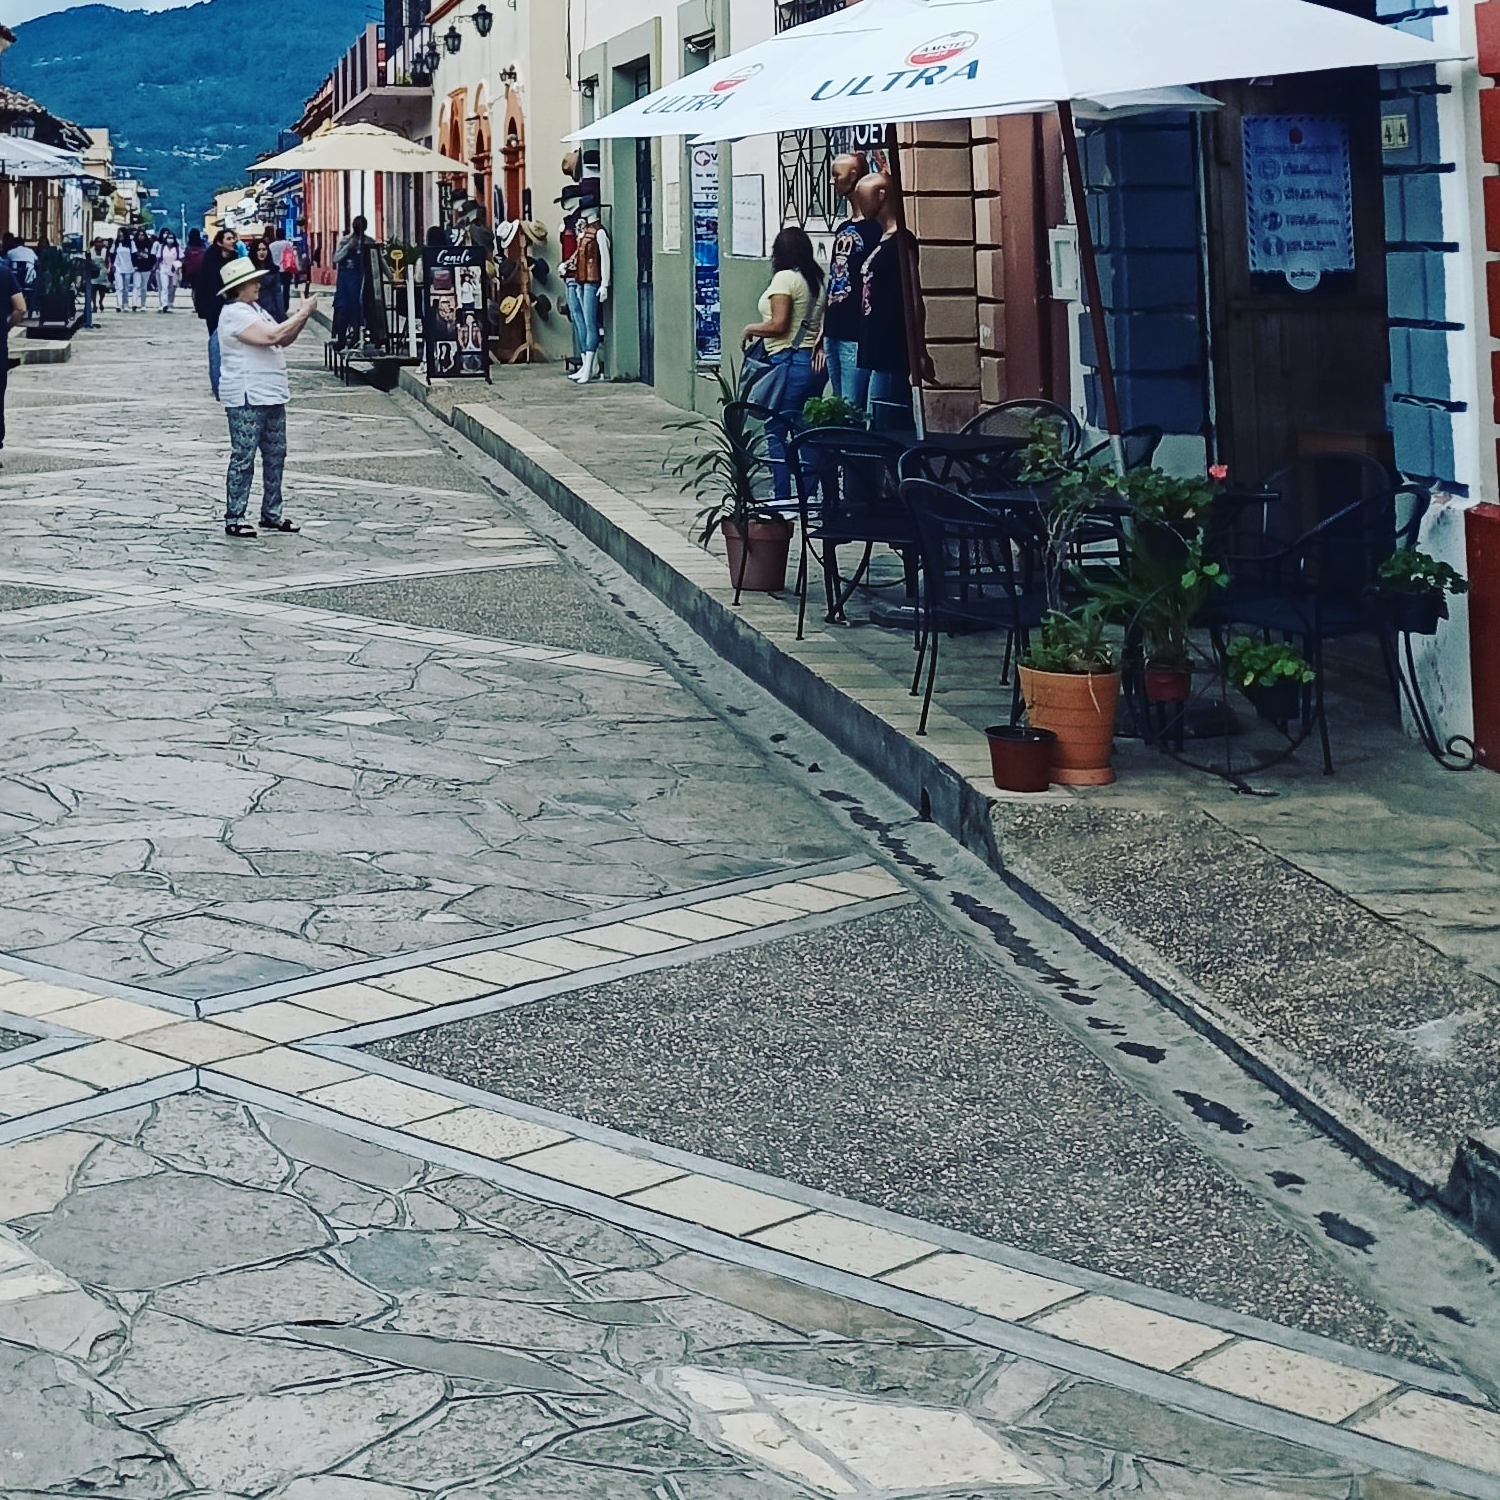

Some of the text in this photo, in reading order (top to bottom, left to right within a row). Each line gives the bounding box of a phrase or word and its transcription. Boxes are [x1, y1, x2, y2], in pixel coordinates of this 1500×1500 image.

[811, 59, 979, 101] ULTRA
[642, 92, 736, 115] ULTRA
[1384, 122, 1406, 143] 44
